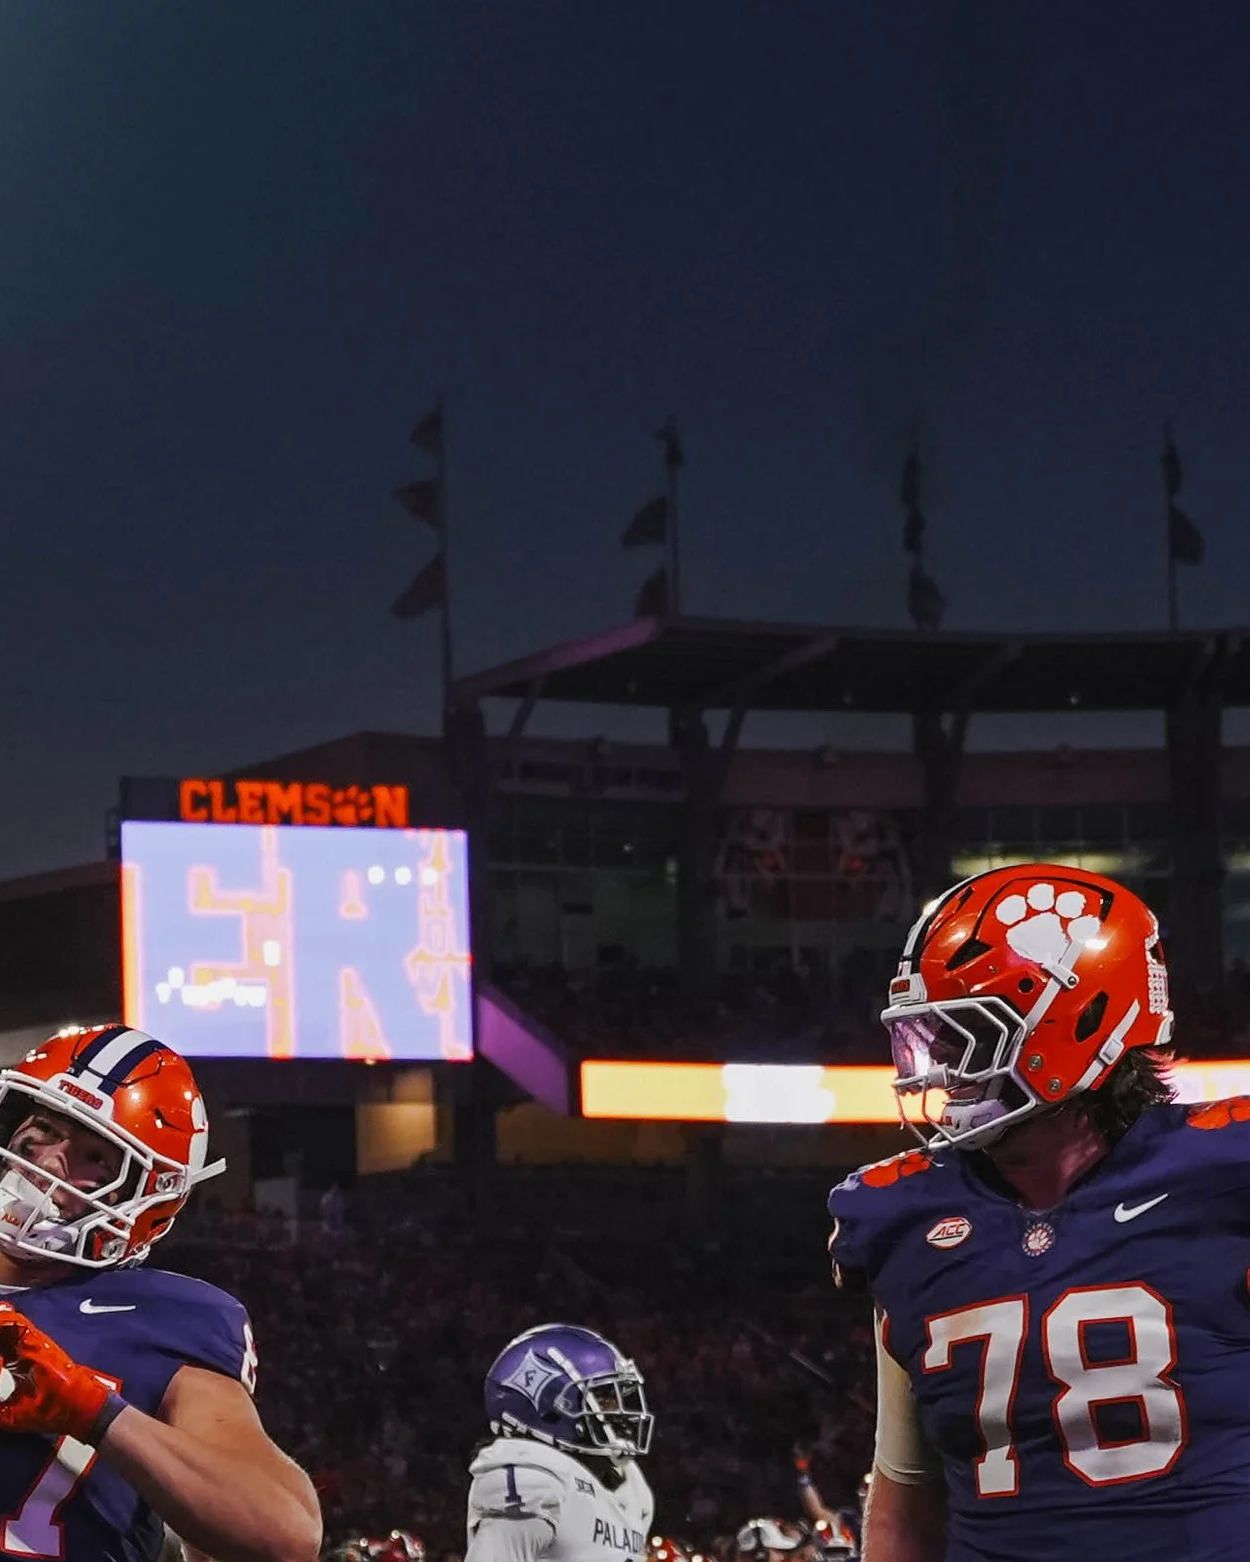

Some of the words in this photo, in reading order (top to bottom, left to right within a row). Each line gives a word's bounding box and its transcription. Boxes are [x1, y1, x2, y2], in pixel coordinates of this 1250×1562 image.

[58, 1079, 103, 1110] TIGERS
[933, 1223, 966, 1238] ACC
[523, 1369, 537, 1388] F
[922, 1280, 1190, 1500] 78
[504, 1463, 524, 1509] 1
